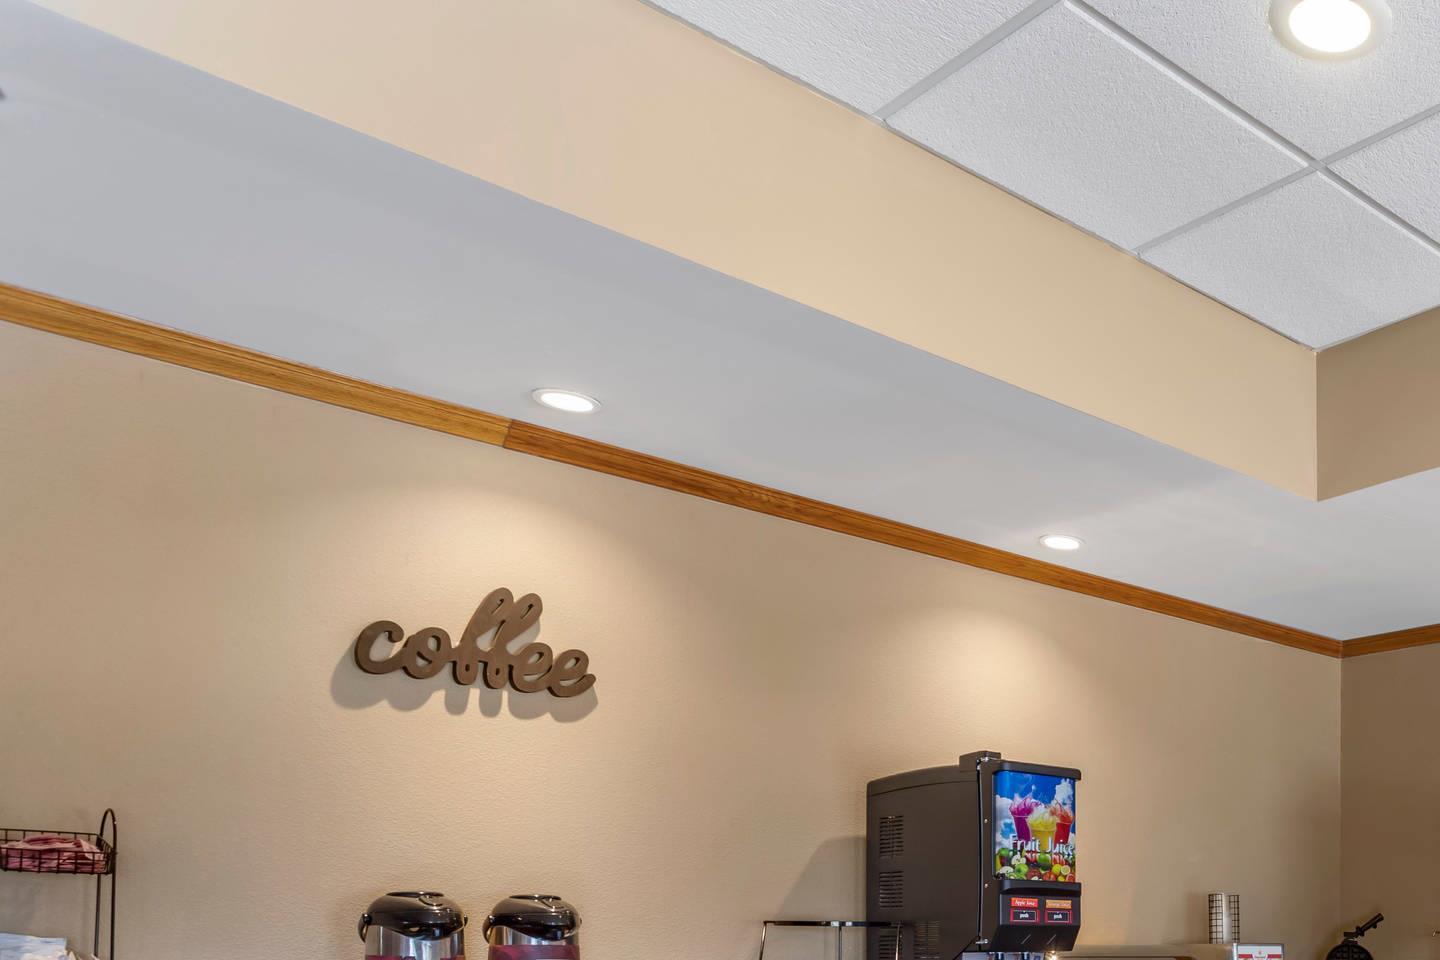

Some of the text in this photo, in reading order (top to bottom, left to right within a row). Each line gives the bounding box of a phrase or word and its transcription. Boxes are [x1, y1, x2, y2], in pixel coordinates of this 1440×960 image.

[354, 587, 597, 698] coffee
[1009, 833, 1075, 855] Fruit Juice
